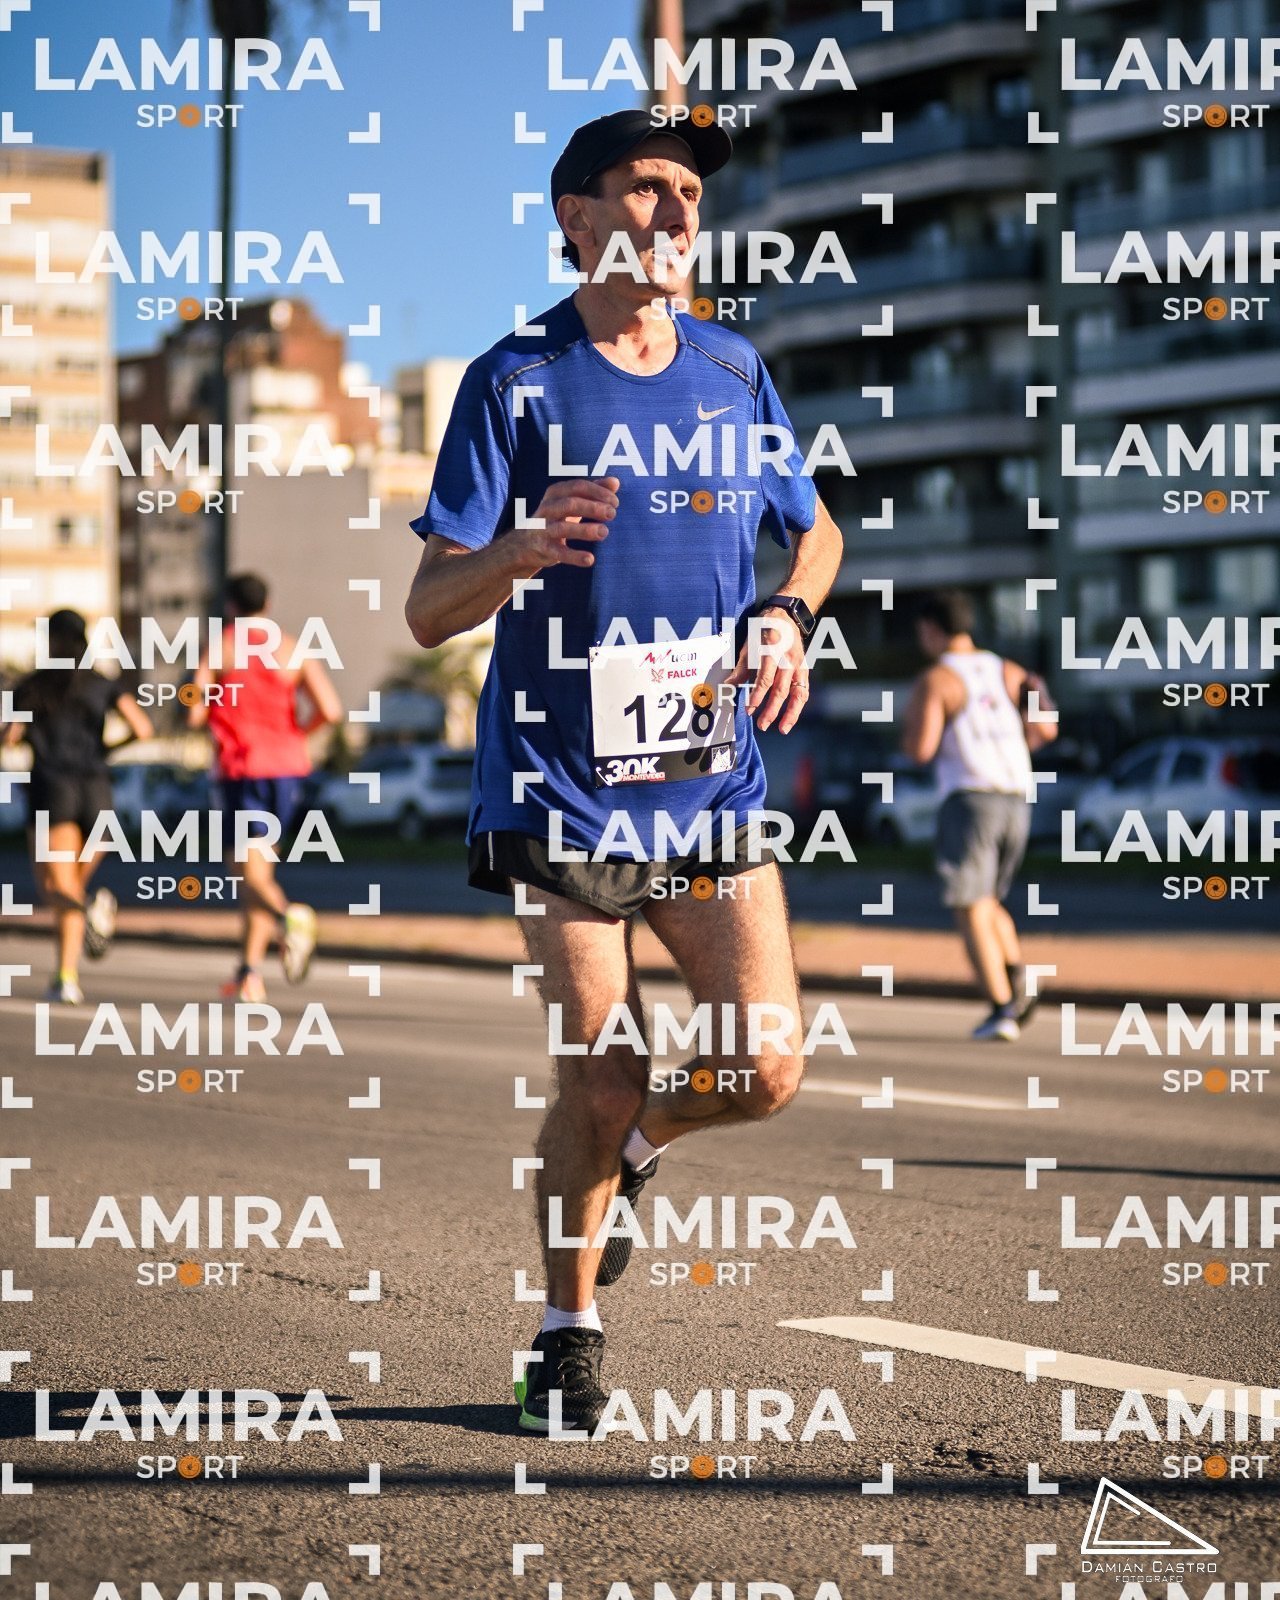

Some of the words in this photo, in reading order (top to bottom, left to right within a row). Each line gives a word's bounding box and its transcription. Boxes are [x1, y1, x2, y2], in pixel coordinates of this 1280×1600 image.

[667, 668, 697, 679] FALCK
[624, 688, 715, 743] 128
[605, 757, 660, 783] 30K
[622, 772, 666, 782] MONTEVIDEO
